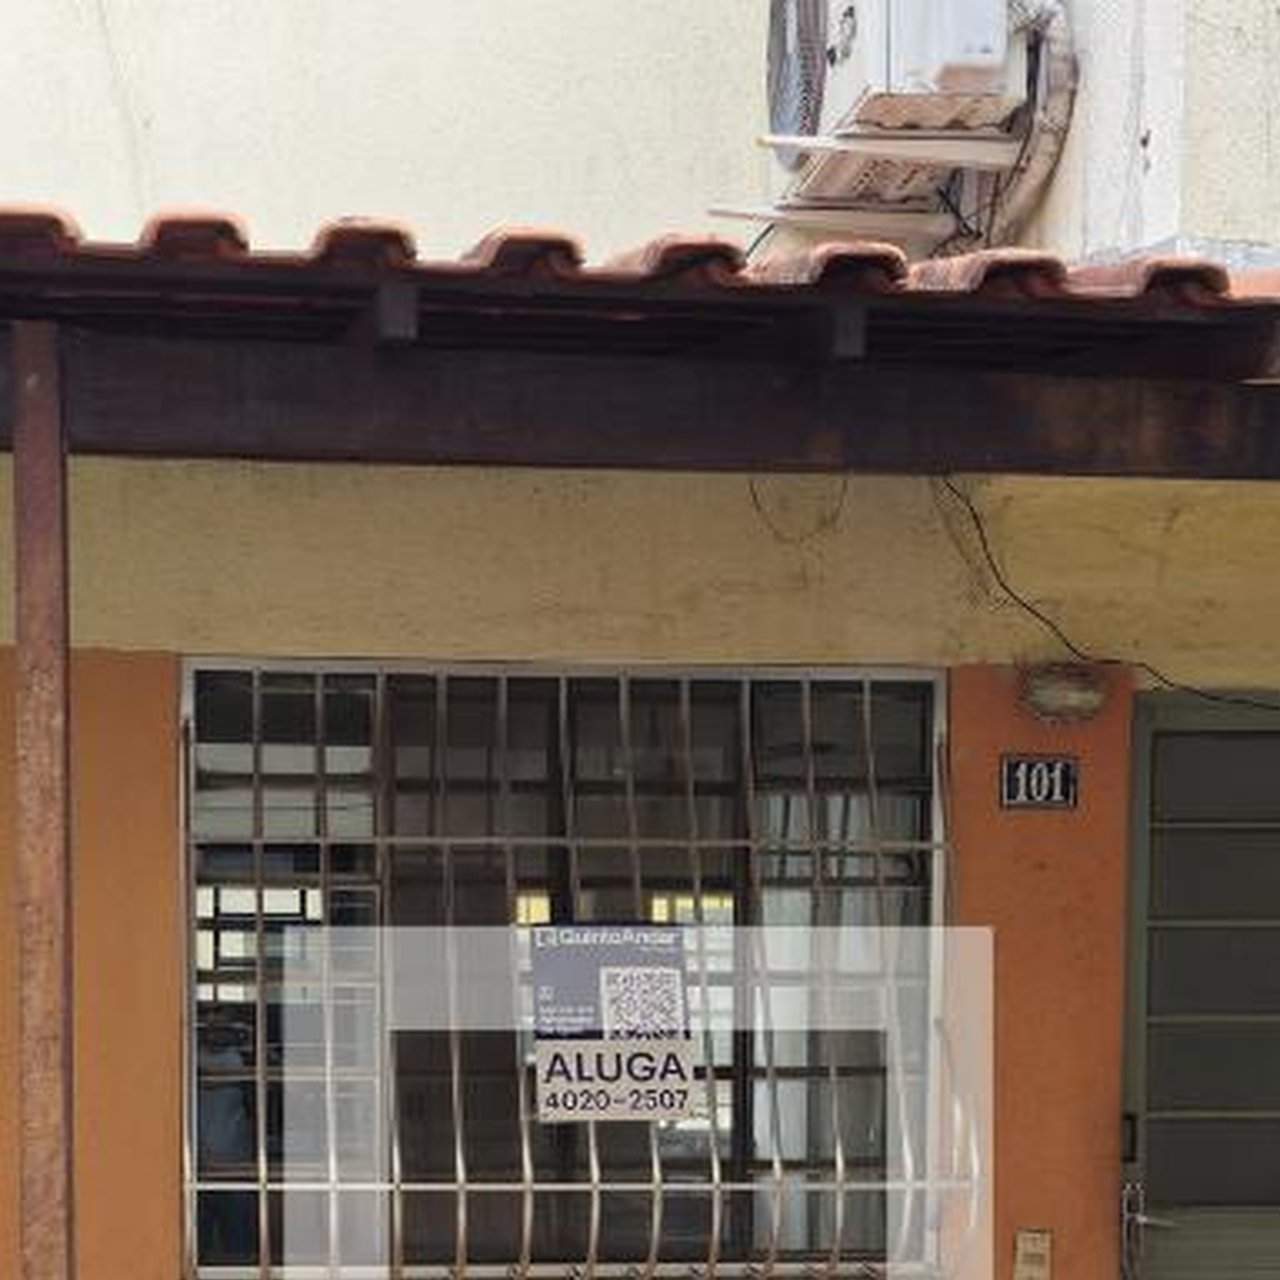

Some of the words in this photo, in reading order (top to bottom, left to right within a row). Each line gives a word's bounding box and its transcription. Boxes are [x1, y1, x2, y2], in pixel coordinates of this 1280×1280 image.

[1015, 761, 1065, 801] 101
[544, 1052, 688, 1083] ALUGA
[545, 1089, 688, 1111] 4020-2507
